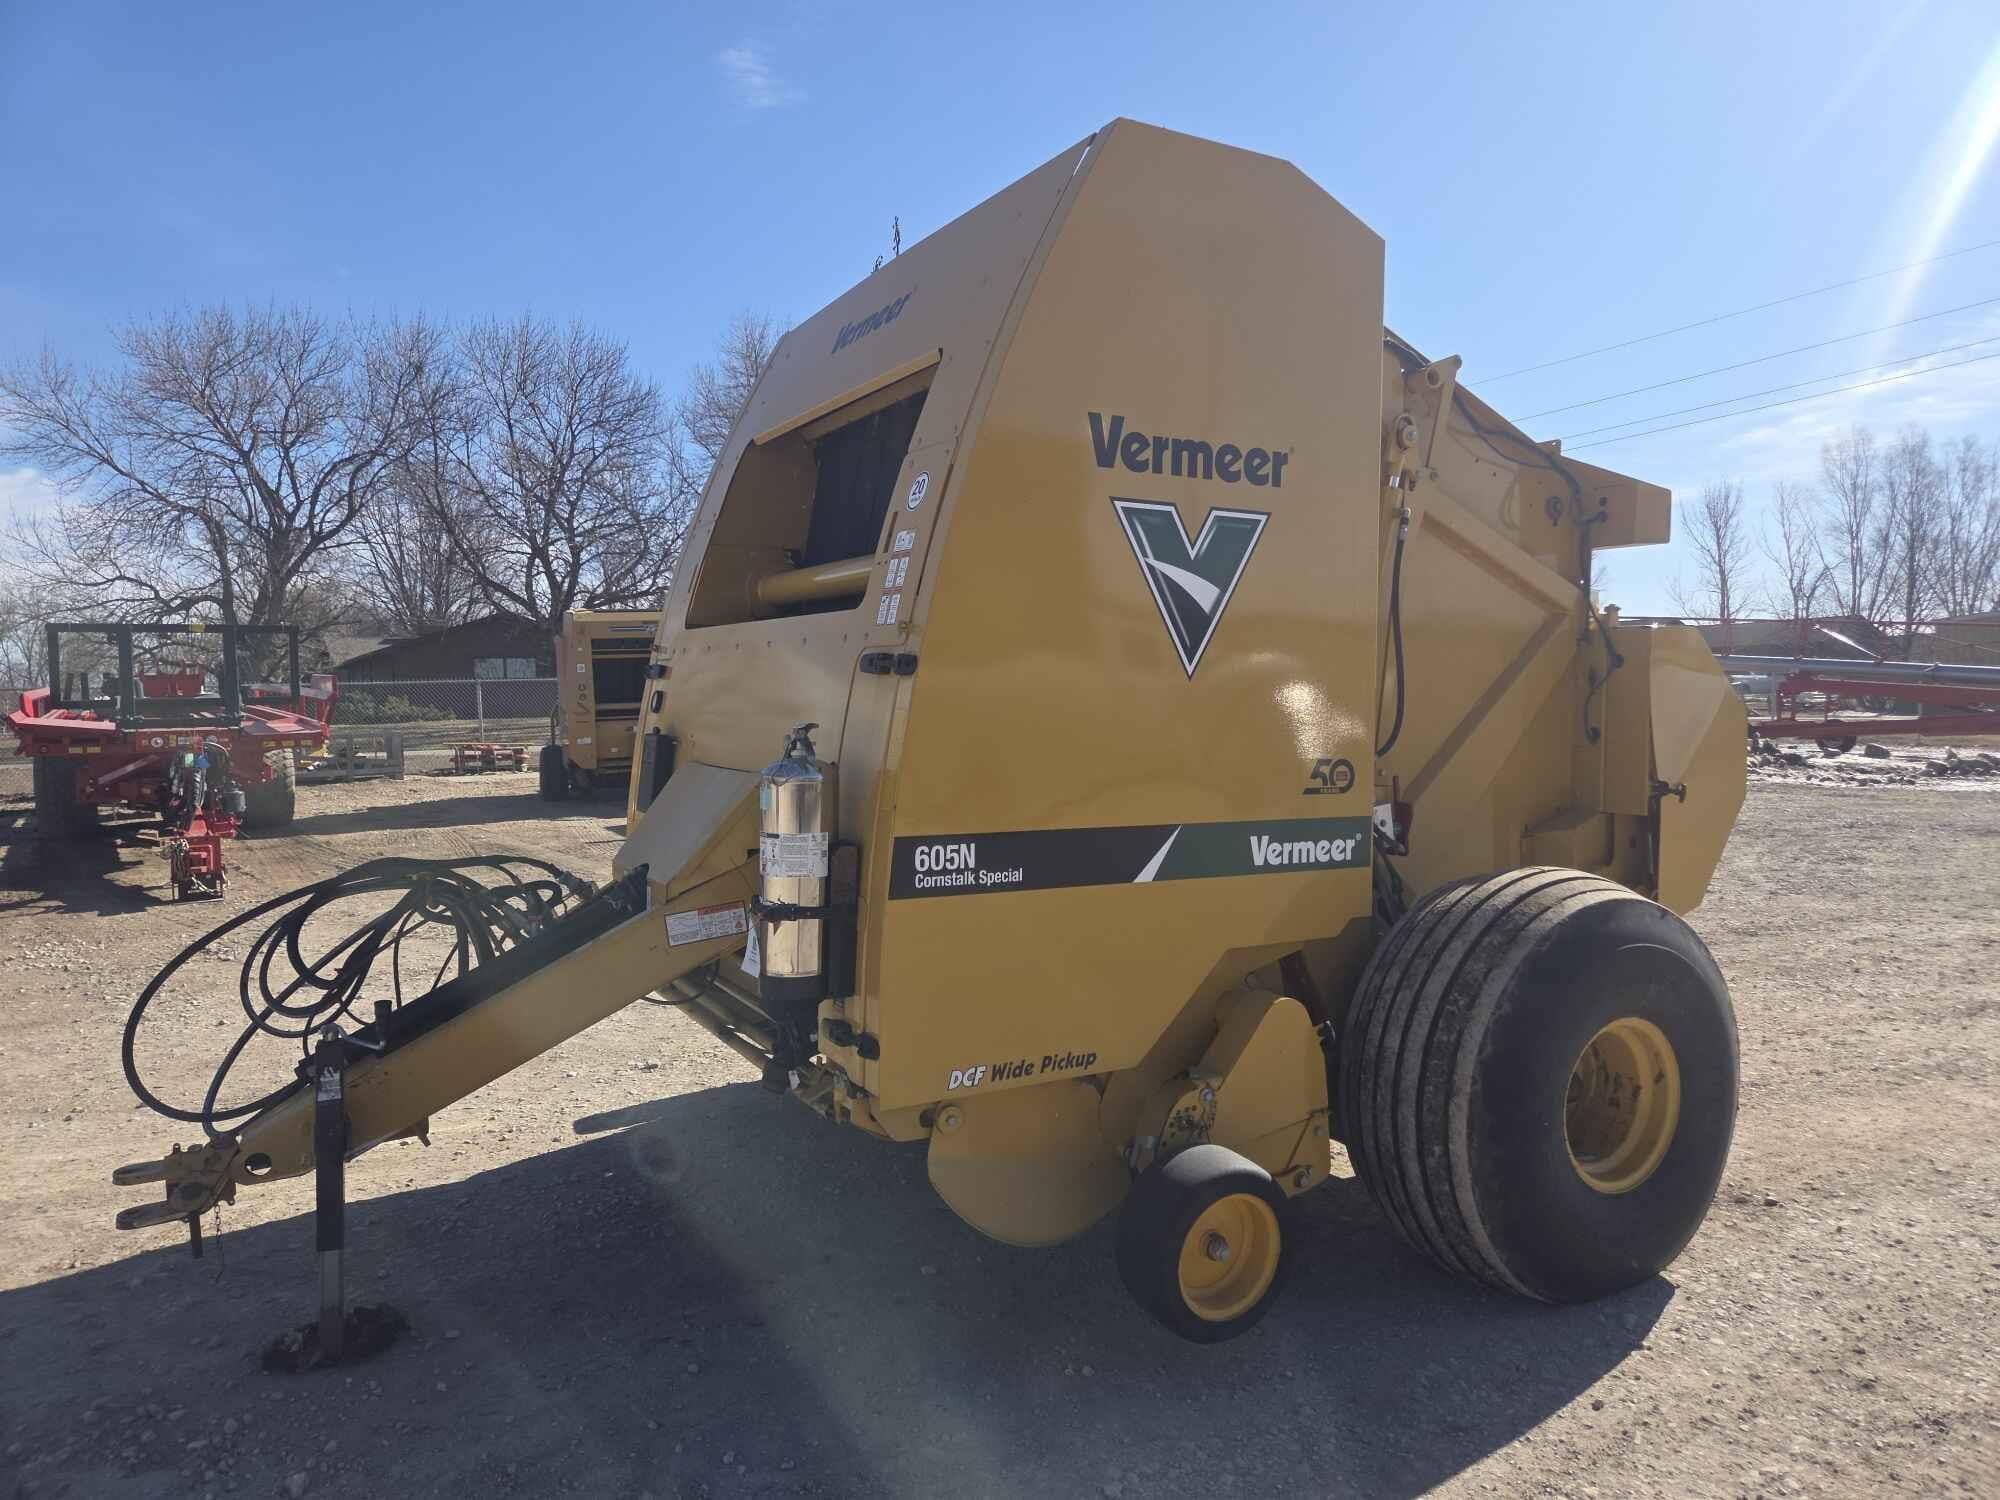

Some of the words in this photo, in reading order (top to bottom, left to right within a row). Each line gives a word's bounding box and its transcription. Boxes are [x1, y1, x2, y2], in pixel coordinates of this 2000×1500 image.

[832, 291, 913, 354] Vermeer
[1088, 411, 1289, 489] Vermeer
[911, 478, 926, 497] 20
[1302, 758, 1355, 795] 50
[914, 842, 976, 872] 605N
[1250, 835, 1356, 866] Vermeer
[915, 871, 976, 889] Cornstalk
[979, 867, 1023, 887] Special
[948, 1063, 988, 1092] DCF
[991, 1059, 1036, 1082] Wide
[1040, 1051, 1097, 1074] Pickup
